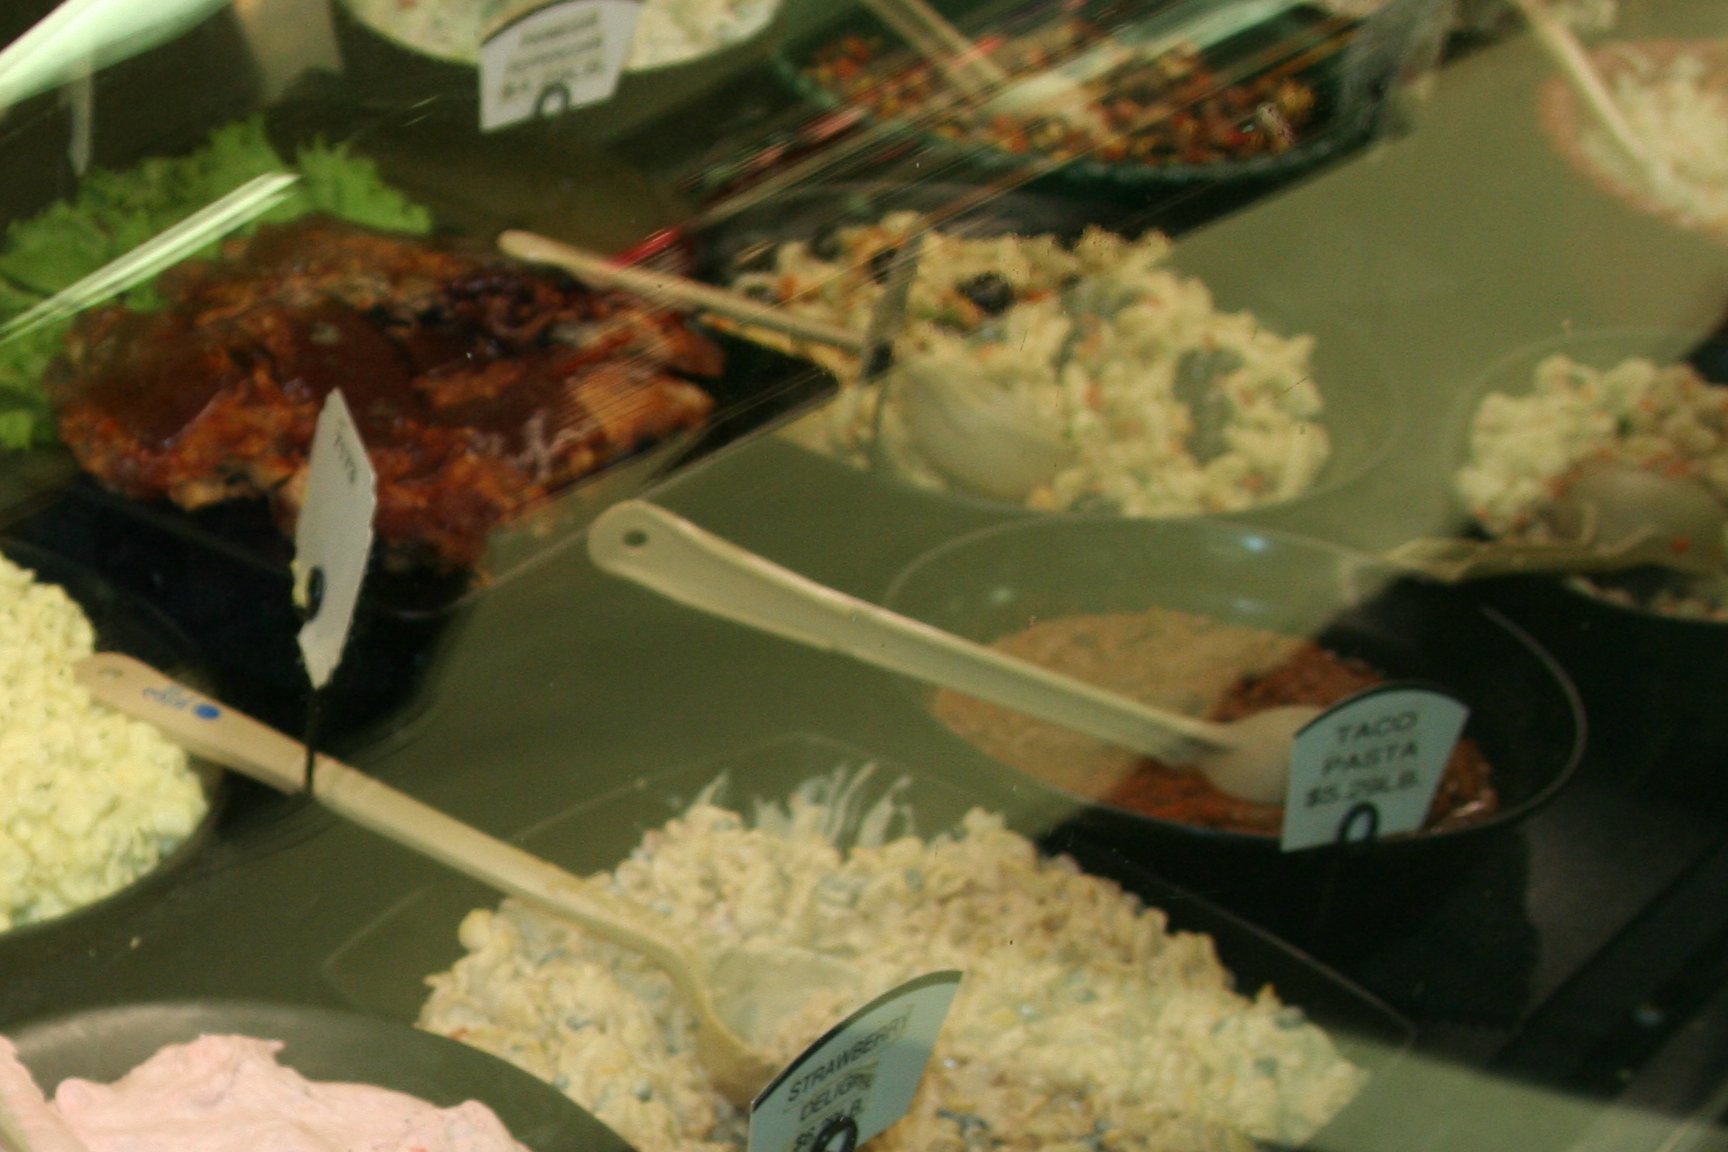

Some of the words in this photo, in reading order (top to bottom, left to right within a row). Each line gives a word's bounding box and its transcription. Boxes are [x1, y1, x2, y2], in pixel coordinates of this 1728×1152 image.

[1336, 710, 1419, 743] TACO
[1322, 741, 1419, 776] PASTA
[787, 1003, 915, 1103] STRAWBERRY
